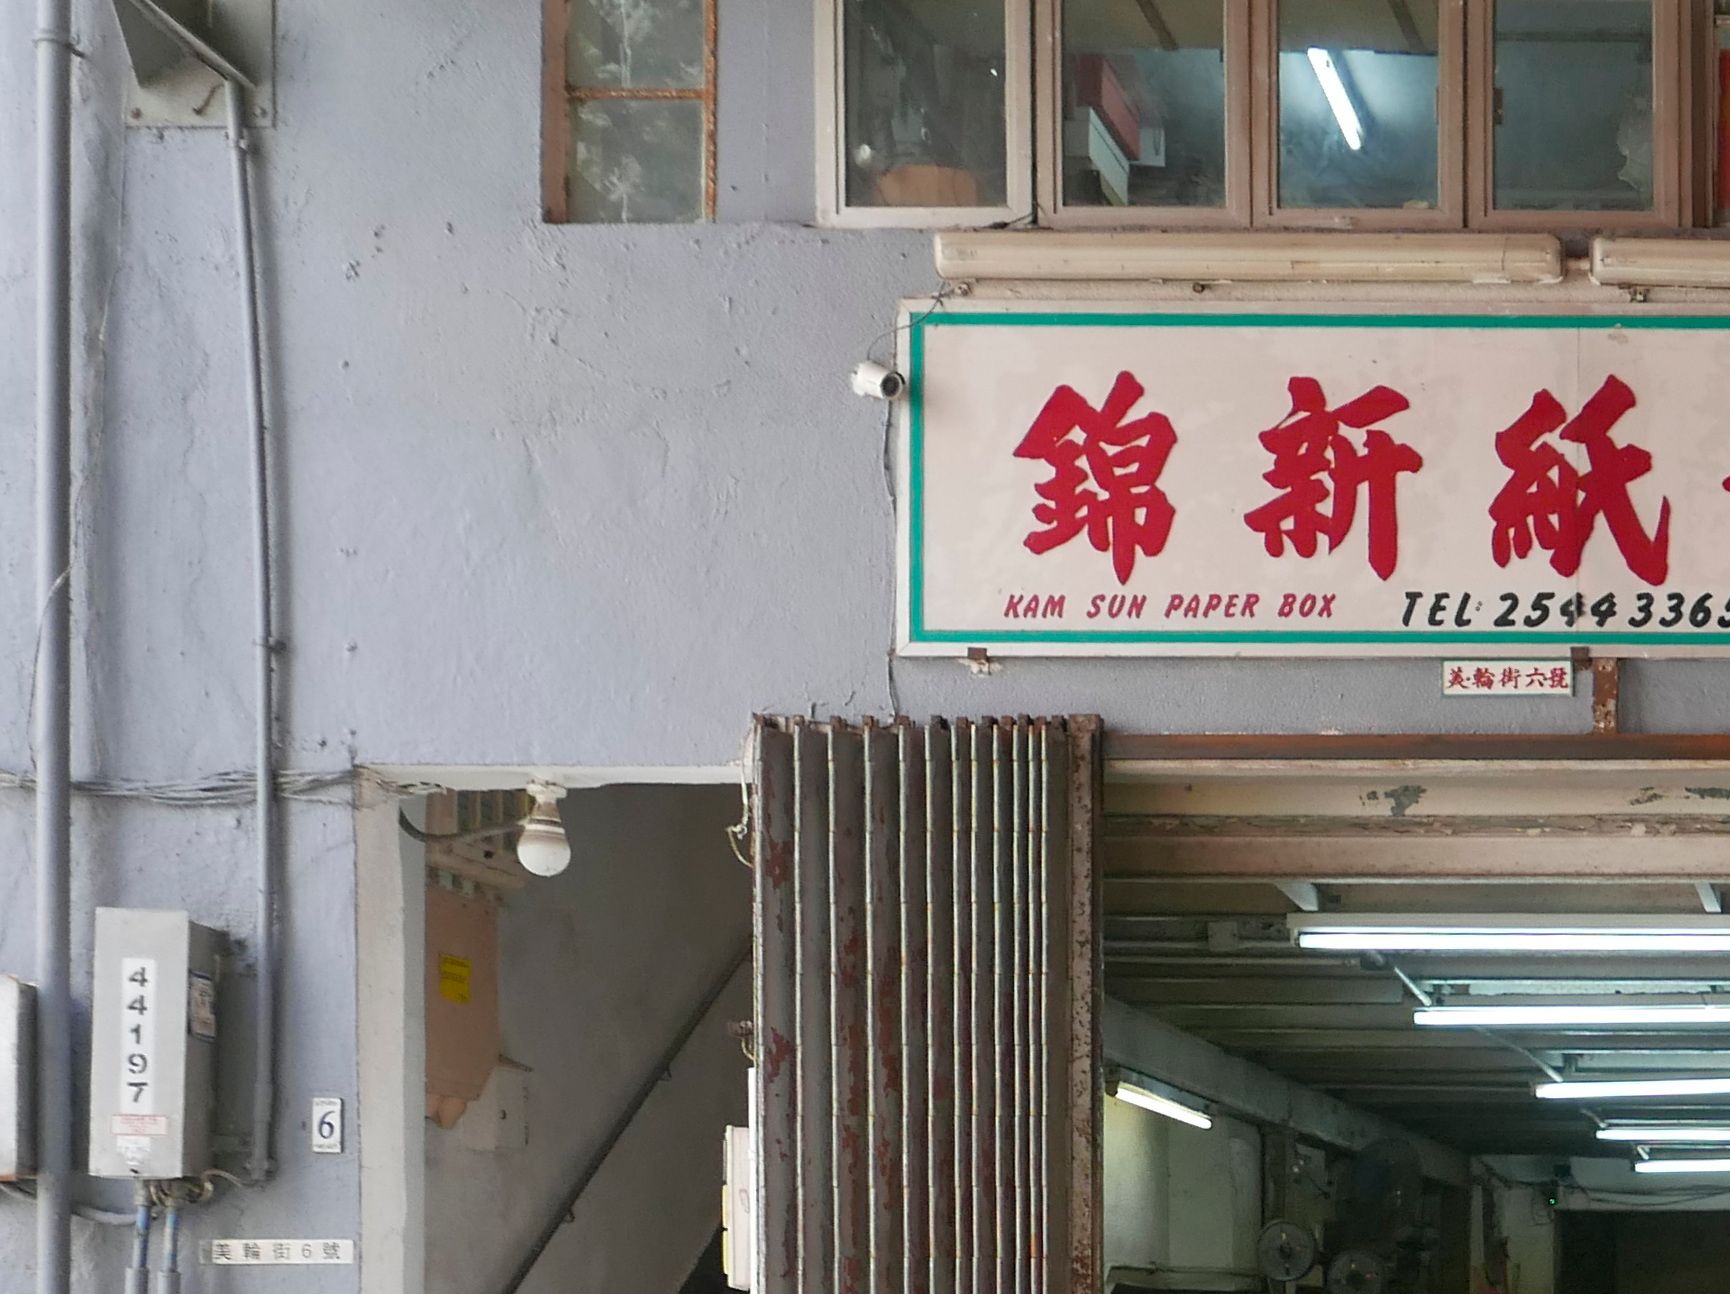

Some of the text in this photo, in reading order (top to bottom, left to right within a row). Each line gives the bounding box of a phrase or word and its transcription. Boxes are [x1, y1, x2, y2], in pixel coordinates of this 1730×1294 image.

[1004, 592, 1338, 619] KAM SUN PAPER BOX
[127, 966, 149, 1103] 44197
[318, 1110, 337, 1140] 6
